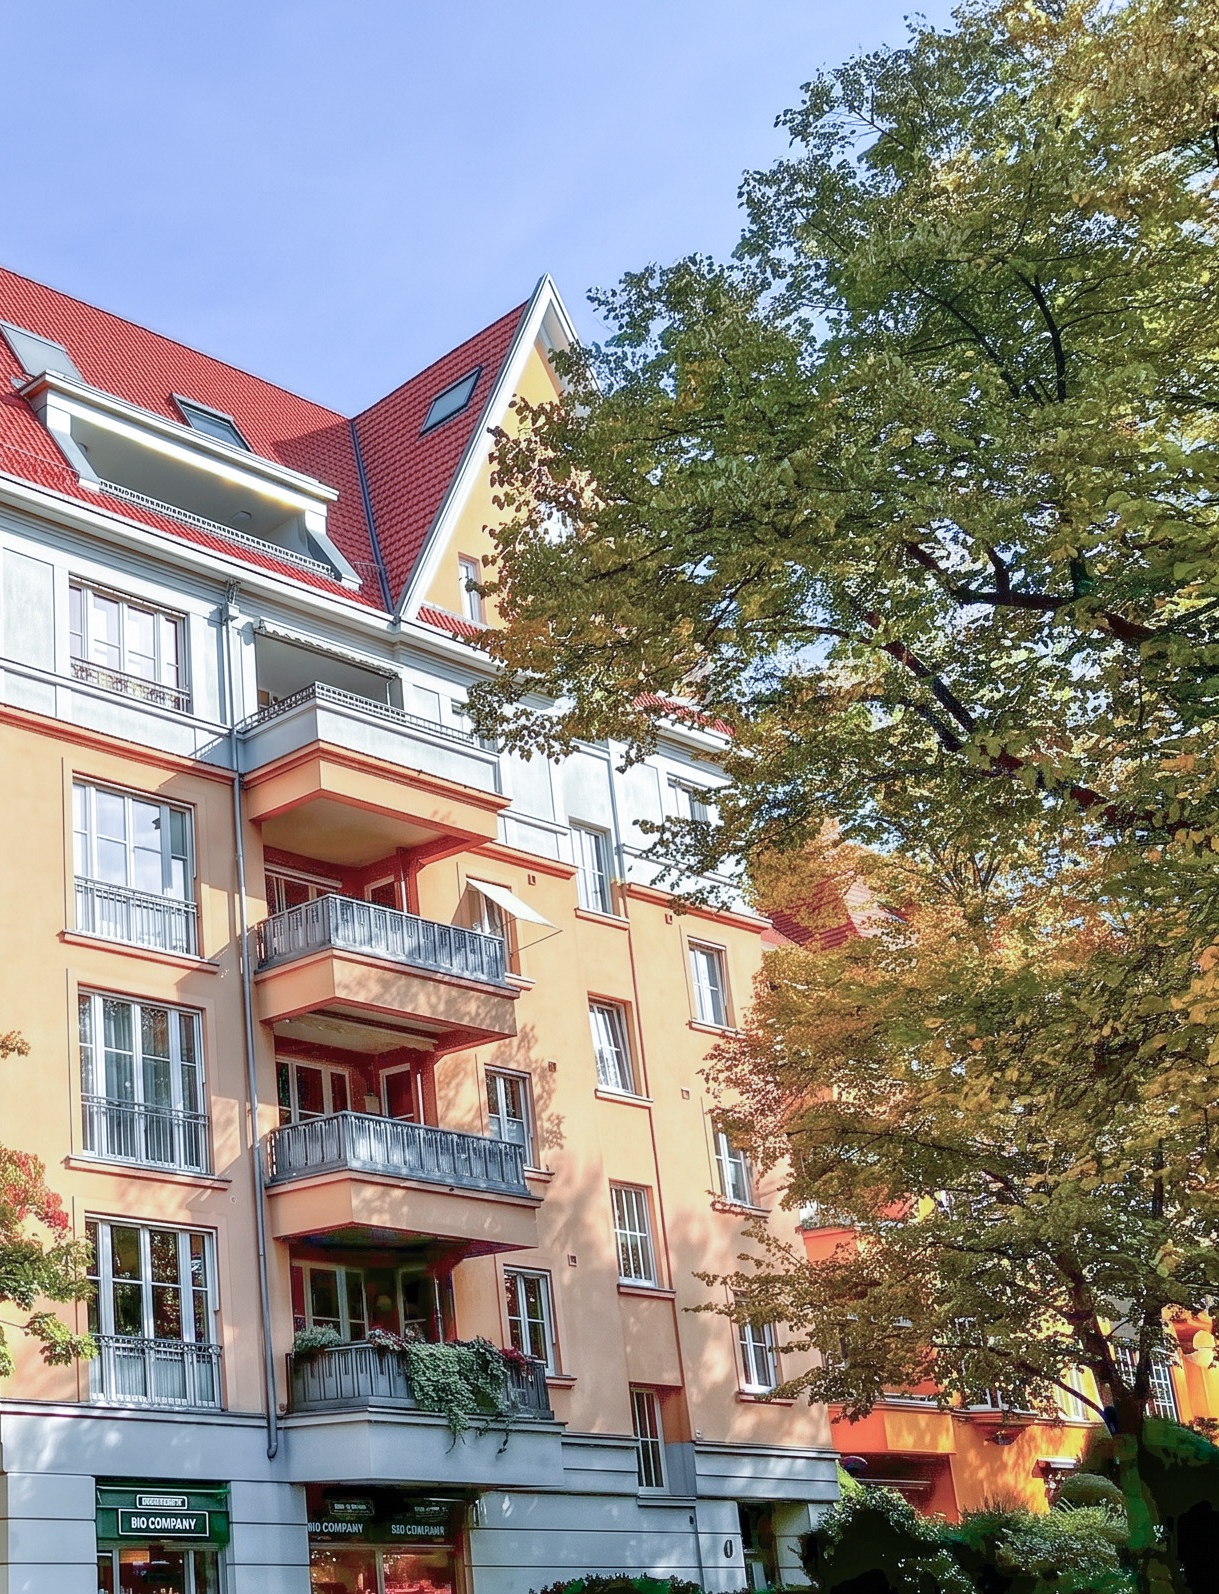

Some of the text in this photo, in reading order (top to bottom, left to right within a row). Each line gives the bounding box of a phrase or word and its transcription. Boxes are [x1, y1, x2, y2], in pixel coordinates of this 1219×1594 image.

[131, 1517, 196, 1530] BIO COMPANY
[322, 1522, 363, 1533] COMPANY
